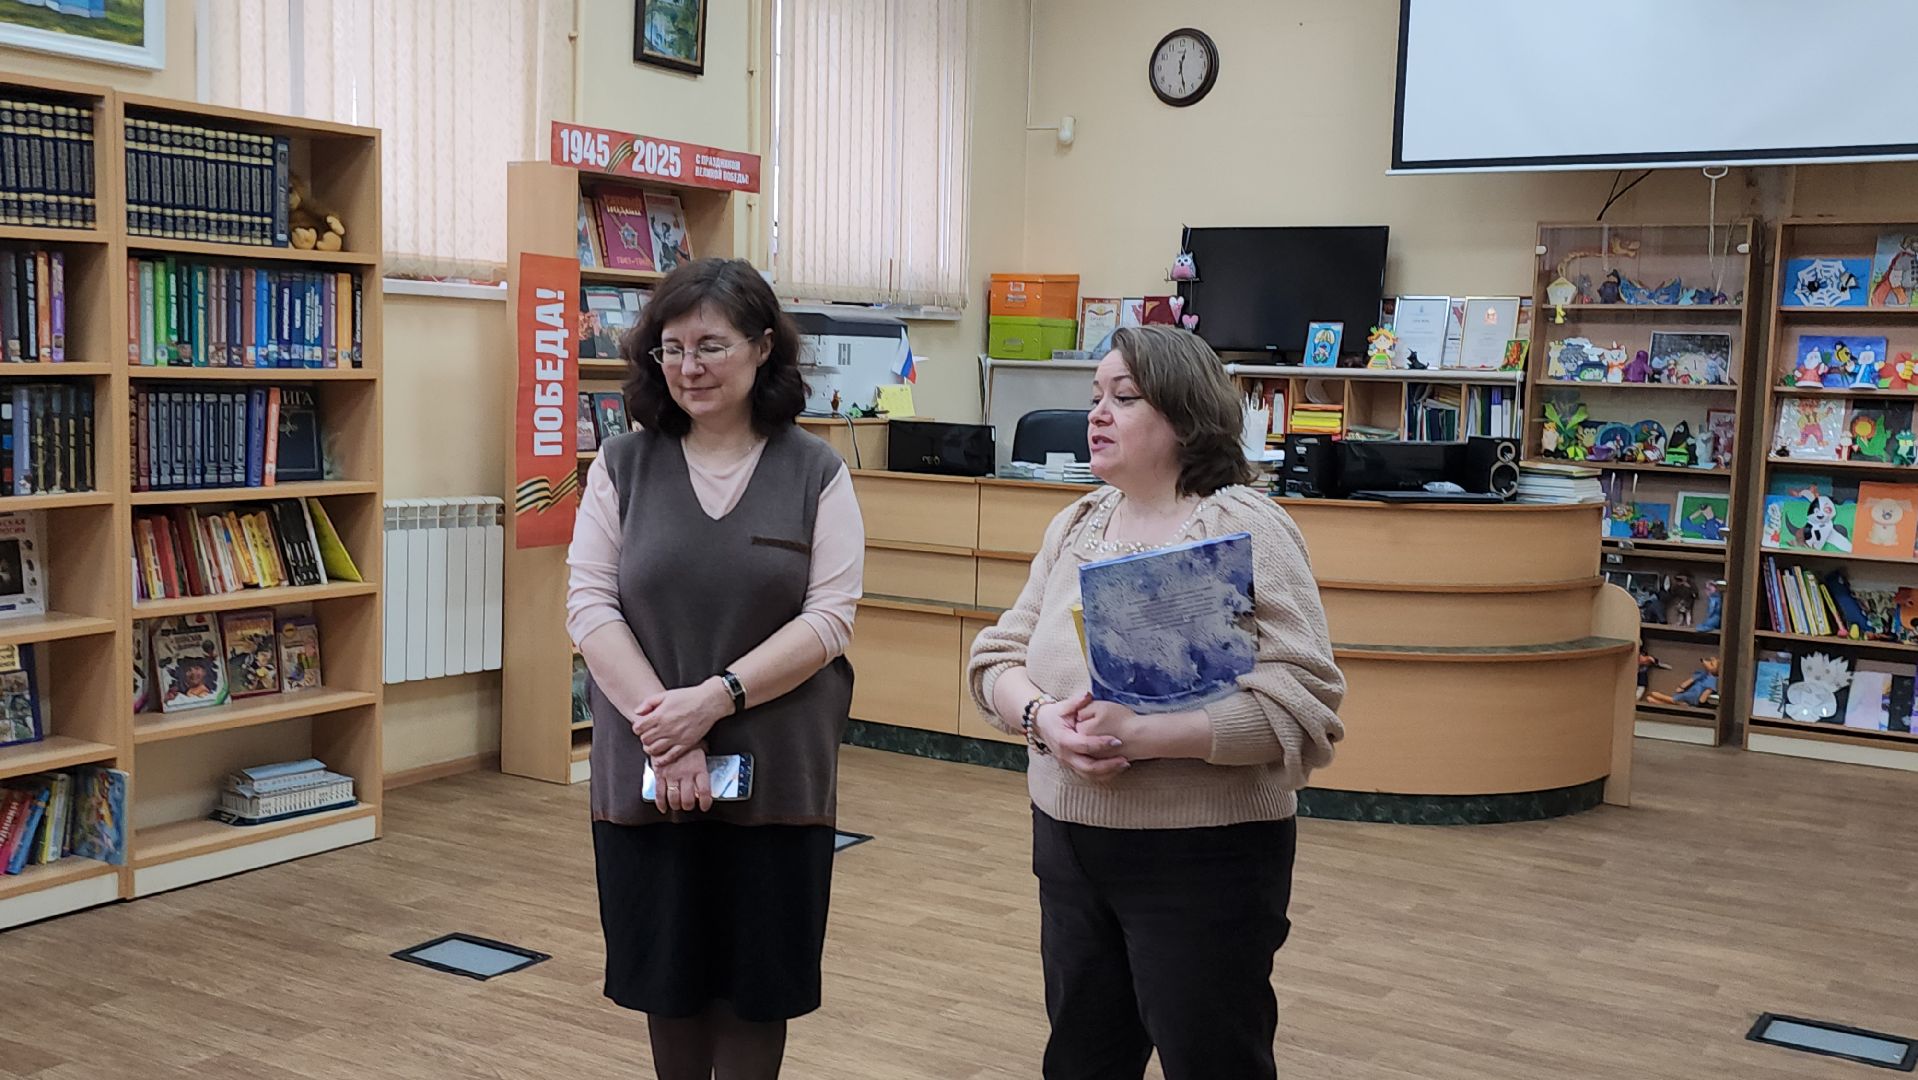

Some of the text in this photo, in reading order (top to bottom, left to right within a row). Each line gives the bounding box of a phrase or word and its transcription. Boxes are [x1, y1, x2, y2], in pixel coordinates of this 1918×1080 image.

[560, 129, 682, 178] 1945 2025
[695, 154, 702, 164] С
[695, 166, 723, 180] ВЕЛИКОЙ
[533, 288, 569, 456] ПОБЕДА!
